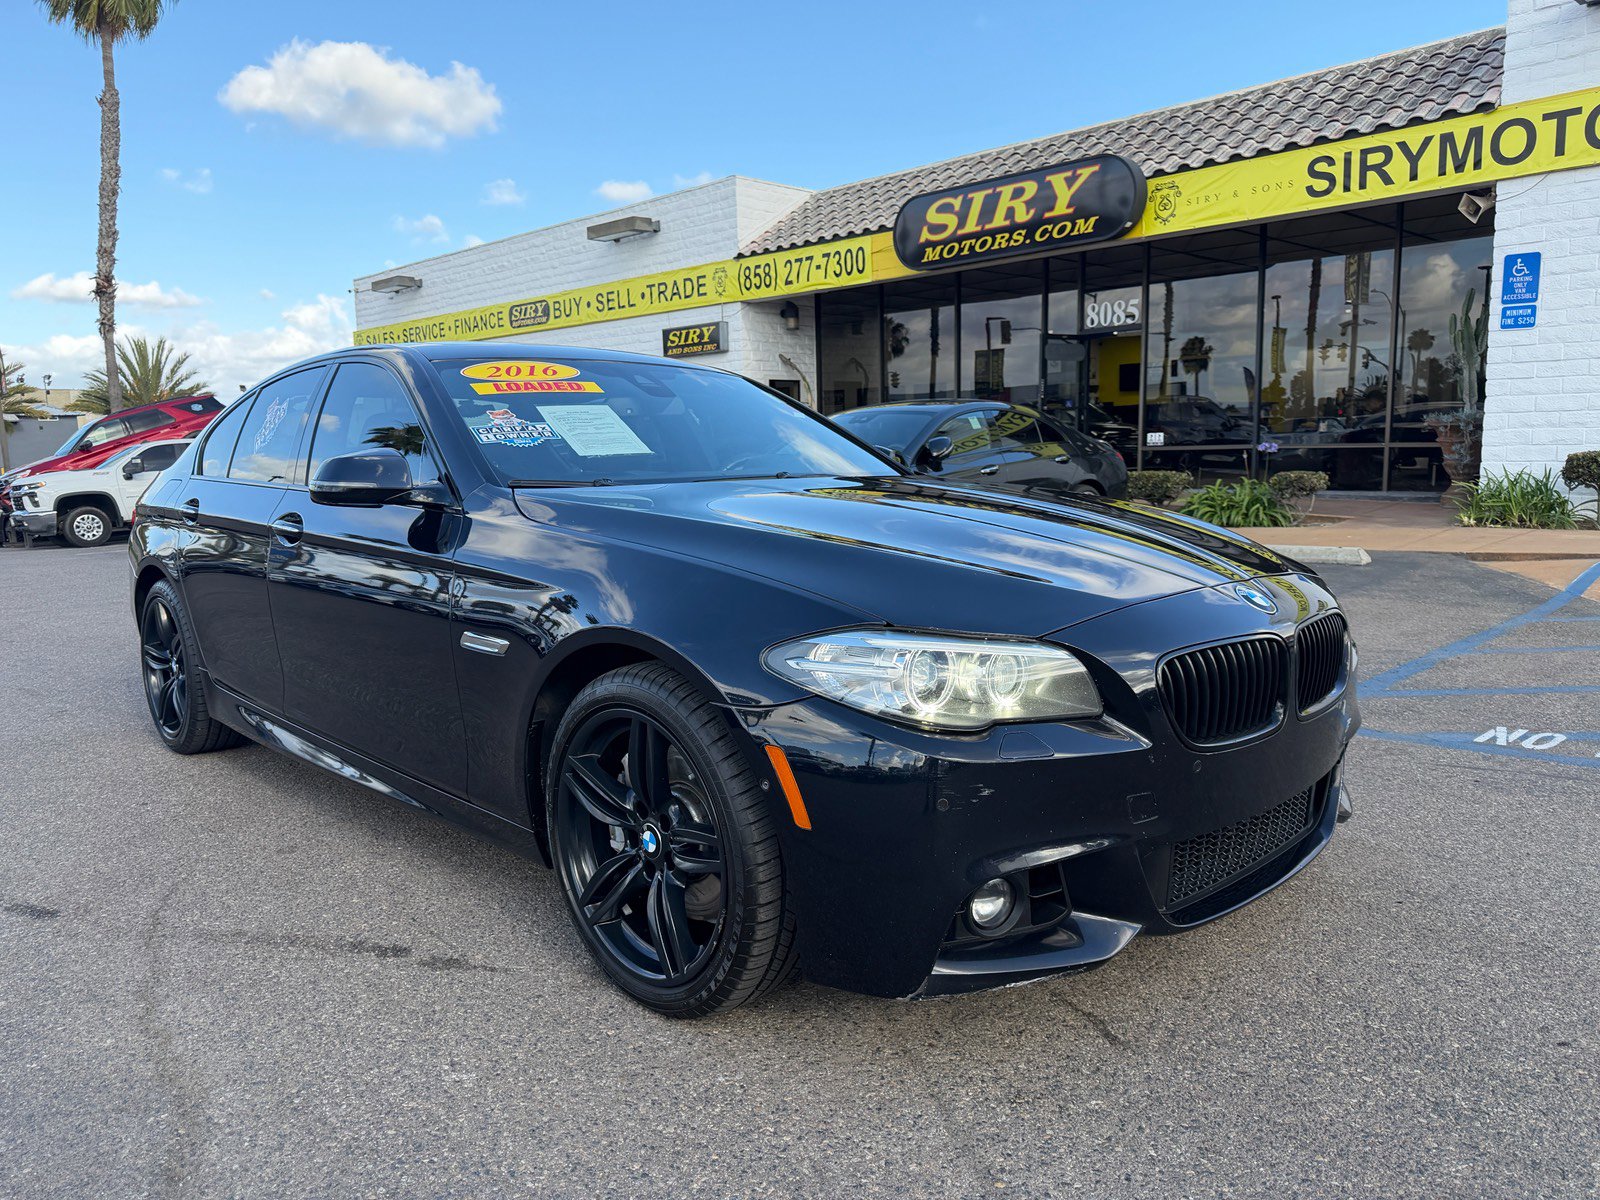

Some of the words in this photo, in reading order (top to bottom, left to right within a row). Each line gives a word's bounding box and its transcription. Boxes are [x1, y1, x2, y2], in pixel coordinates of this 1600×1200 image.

[1186, 192, 1221, 206] SIRY
[1232, 189, 1240, 198] &
[1251, 179, 1294, 195] SONS
[919, 164, 1101, 244] SIRY
[921, 215, 1099, 263] MOTORS.COM
[738, 258, 778, 296] (858)
[784, 246, 866, 287] 277-7300
[552, 296, 582, 319] BUY
[596, 288, 636, 312] SELL
[646, 275, 707, 304] TRADE
[1503, 293, 1537, 301] ACCESSIBLE
[511, 302, 547, 321] SIRY
[1086, 299, 1140, 328] 8085
[1517, 317, 1535, 325] $250
[366, 331, 395, 344] SALES
[402, 321, 446, 343] SERVICE
[454, 311, 504, 335] FINANCE
[667, 325, 716, 347] SIRY
[667, 347, 683, 355] AND
[683, 345, 702, 353] SONS
[703, 343, 717, 351] INC
[486, 365, 558, 378] 2016
[492, 381, 586, 393] LOADED
[478, 424, 548, 434] CARFAX
[496, 431, 554, 440] OWNER
[1473, 726, 1567, 749] NO
